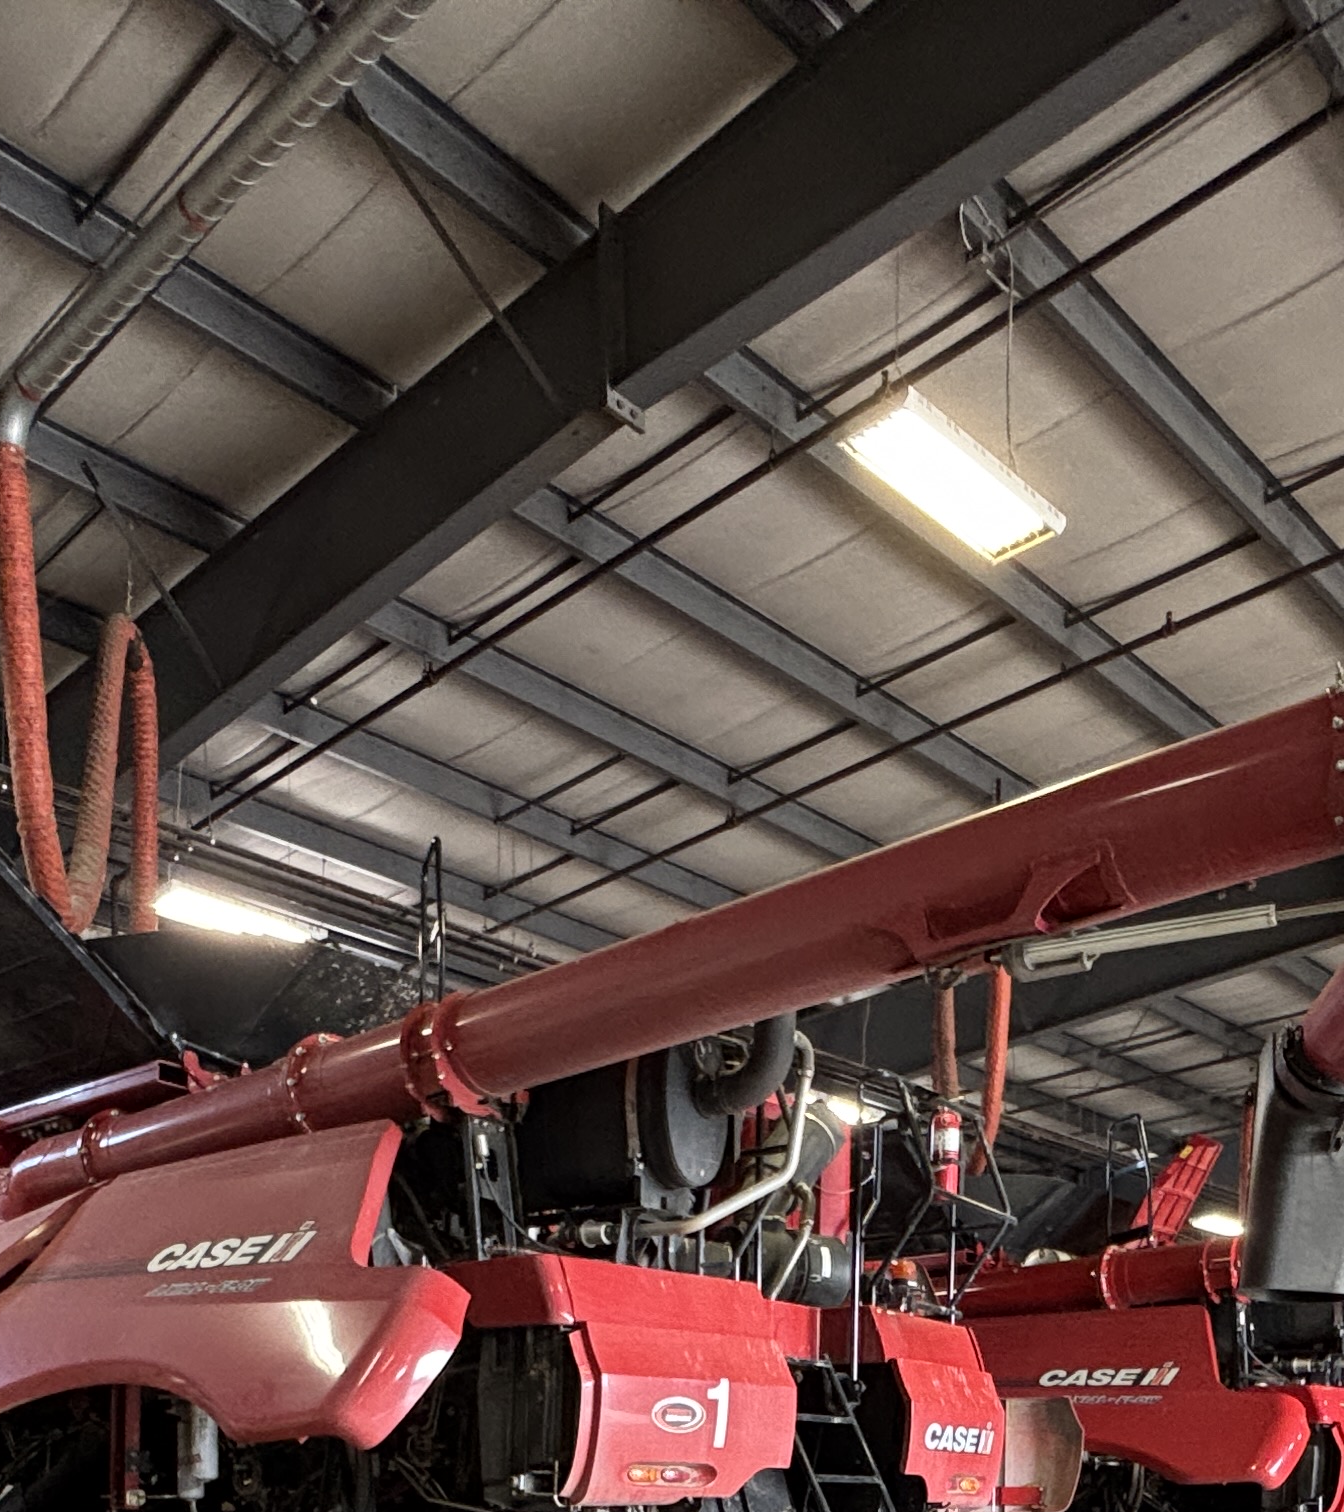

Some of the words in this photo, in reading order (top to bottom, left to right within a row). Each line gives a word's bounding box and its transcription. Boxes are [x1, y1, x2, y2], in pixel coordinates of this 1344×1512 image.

[146, 1234, 274, 1273] CASE
[1039, 1368, 1143, 1386] CASE
[706, 1377, 730, 1448] 1
[924, 1422, 980, 1453] CASE
